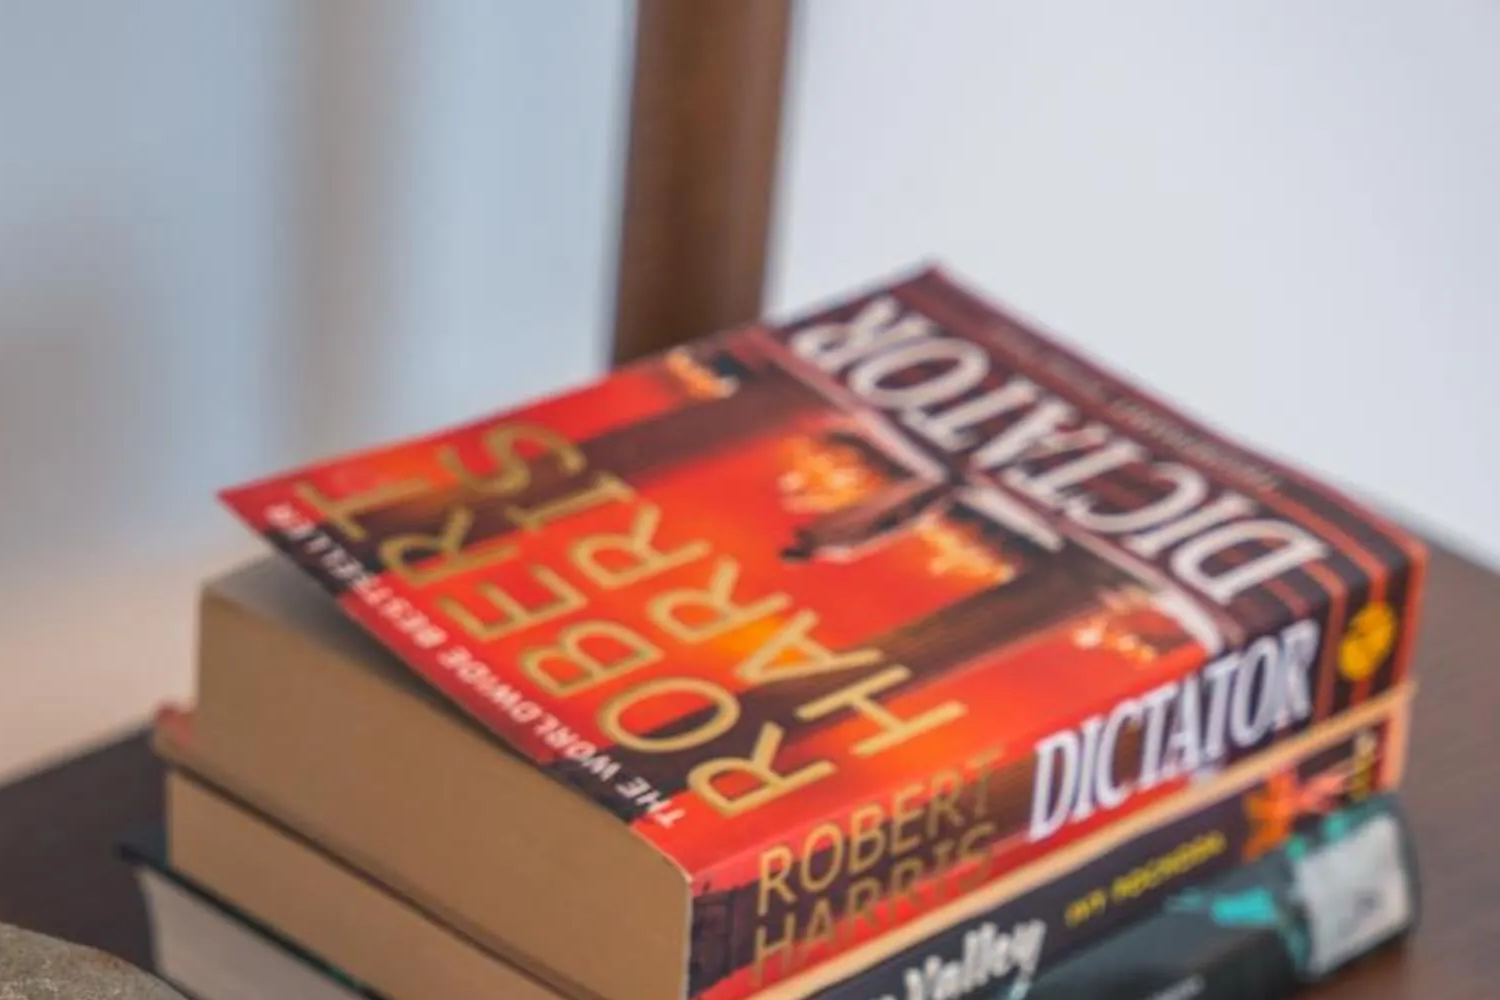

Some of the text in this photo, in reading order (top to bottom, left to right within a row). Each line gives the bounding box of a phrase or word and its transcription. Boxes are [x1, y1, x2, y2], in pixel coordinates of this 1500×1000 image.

[435, 422, 967, 757] HARRIS
[790, 297, 1328, 606] DICTATOR
[264, 501, 687, 829] THE WORLDWIDE BESTSELLER
[295, 472, 836, 817] ROBERT
[1028, 620, 1320, 841] DICTATOR
[750, 824, 998, 988] HARRIS
[756, 747, 1004, 916] ROBERT
